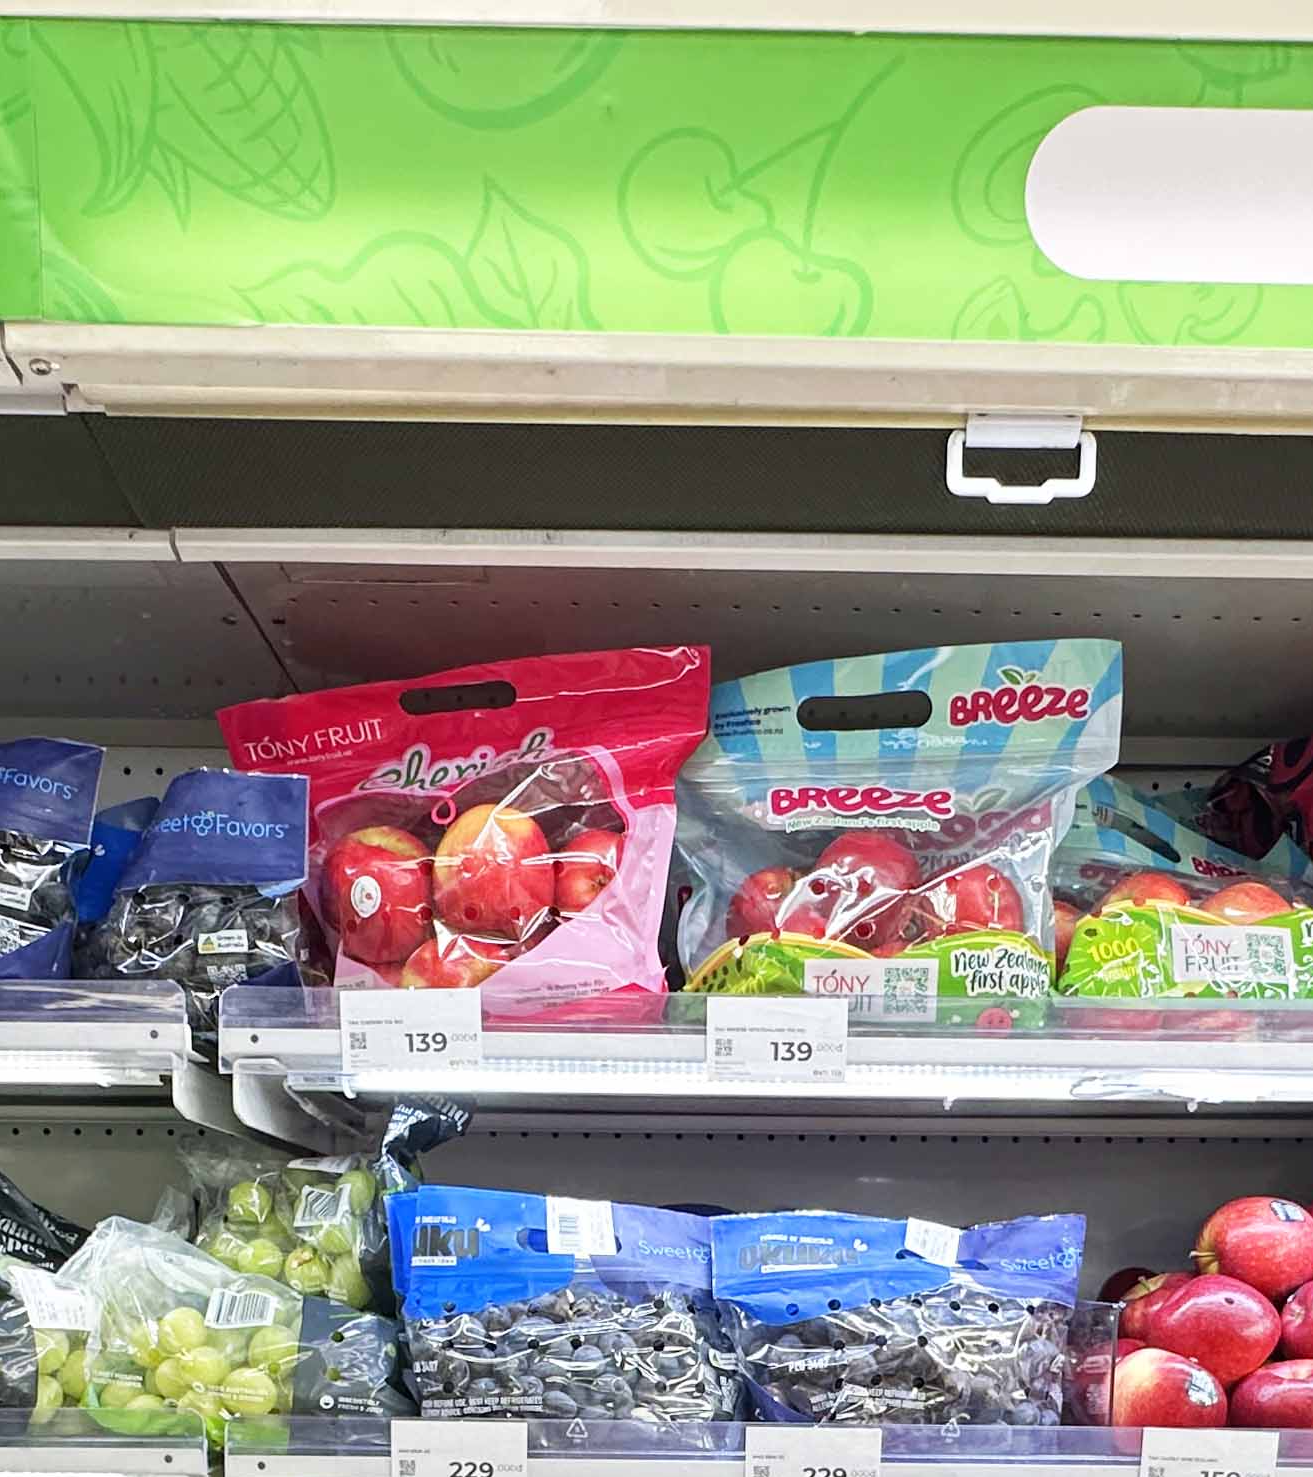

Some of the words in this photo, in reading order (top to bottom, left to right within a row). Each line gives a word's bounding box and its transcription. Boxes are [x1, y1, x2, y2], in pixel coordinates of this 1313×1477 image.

[244, 735, 309, 762] TÓNY
[314, 719, 383, 749] FRUIT
[3, 768, 73, 800] Favors
[216, 813, 287, 839] Favors
[812, 969, 871, 994] TÓNY
[969, 969, 1005, 993] first
[404, 1032, 448, 1053] 139
[770, 1041, 813, 1062] 139
